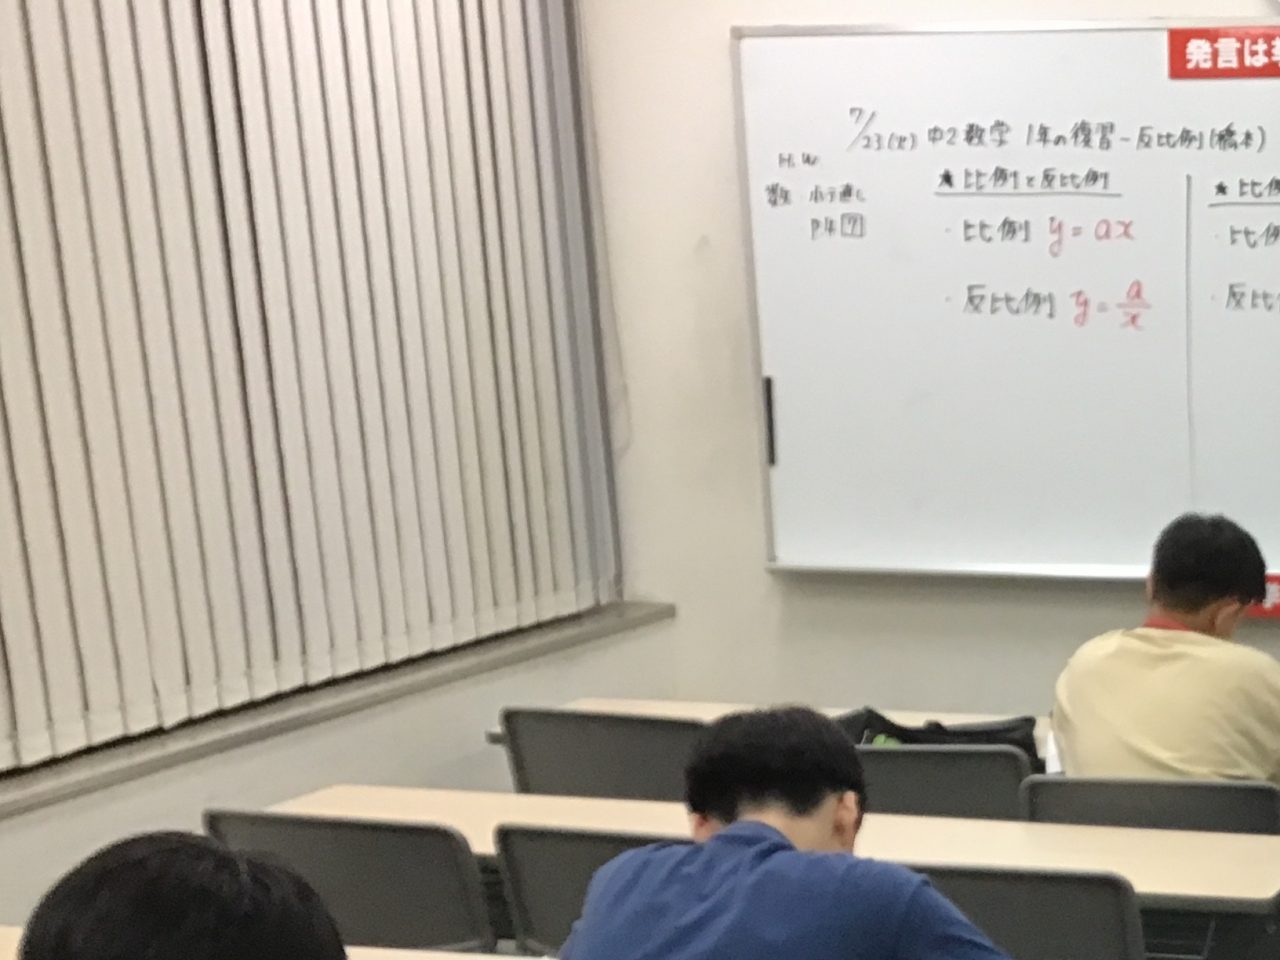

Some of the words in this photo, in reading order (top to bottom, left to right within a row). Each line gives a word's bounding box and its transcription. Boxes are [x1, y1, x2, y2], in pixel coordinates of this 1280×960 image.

[927, 119, 1012, 148] 中2数学
[963, 216, 1031, 244] 比例
[964, 284, 1056, 320] 反比例
